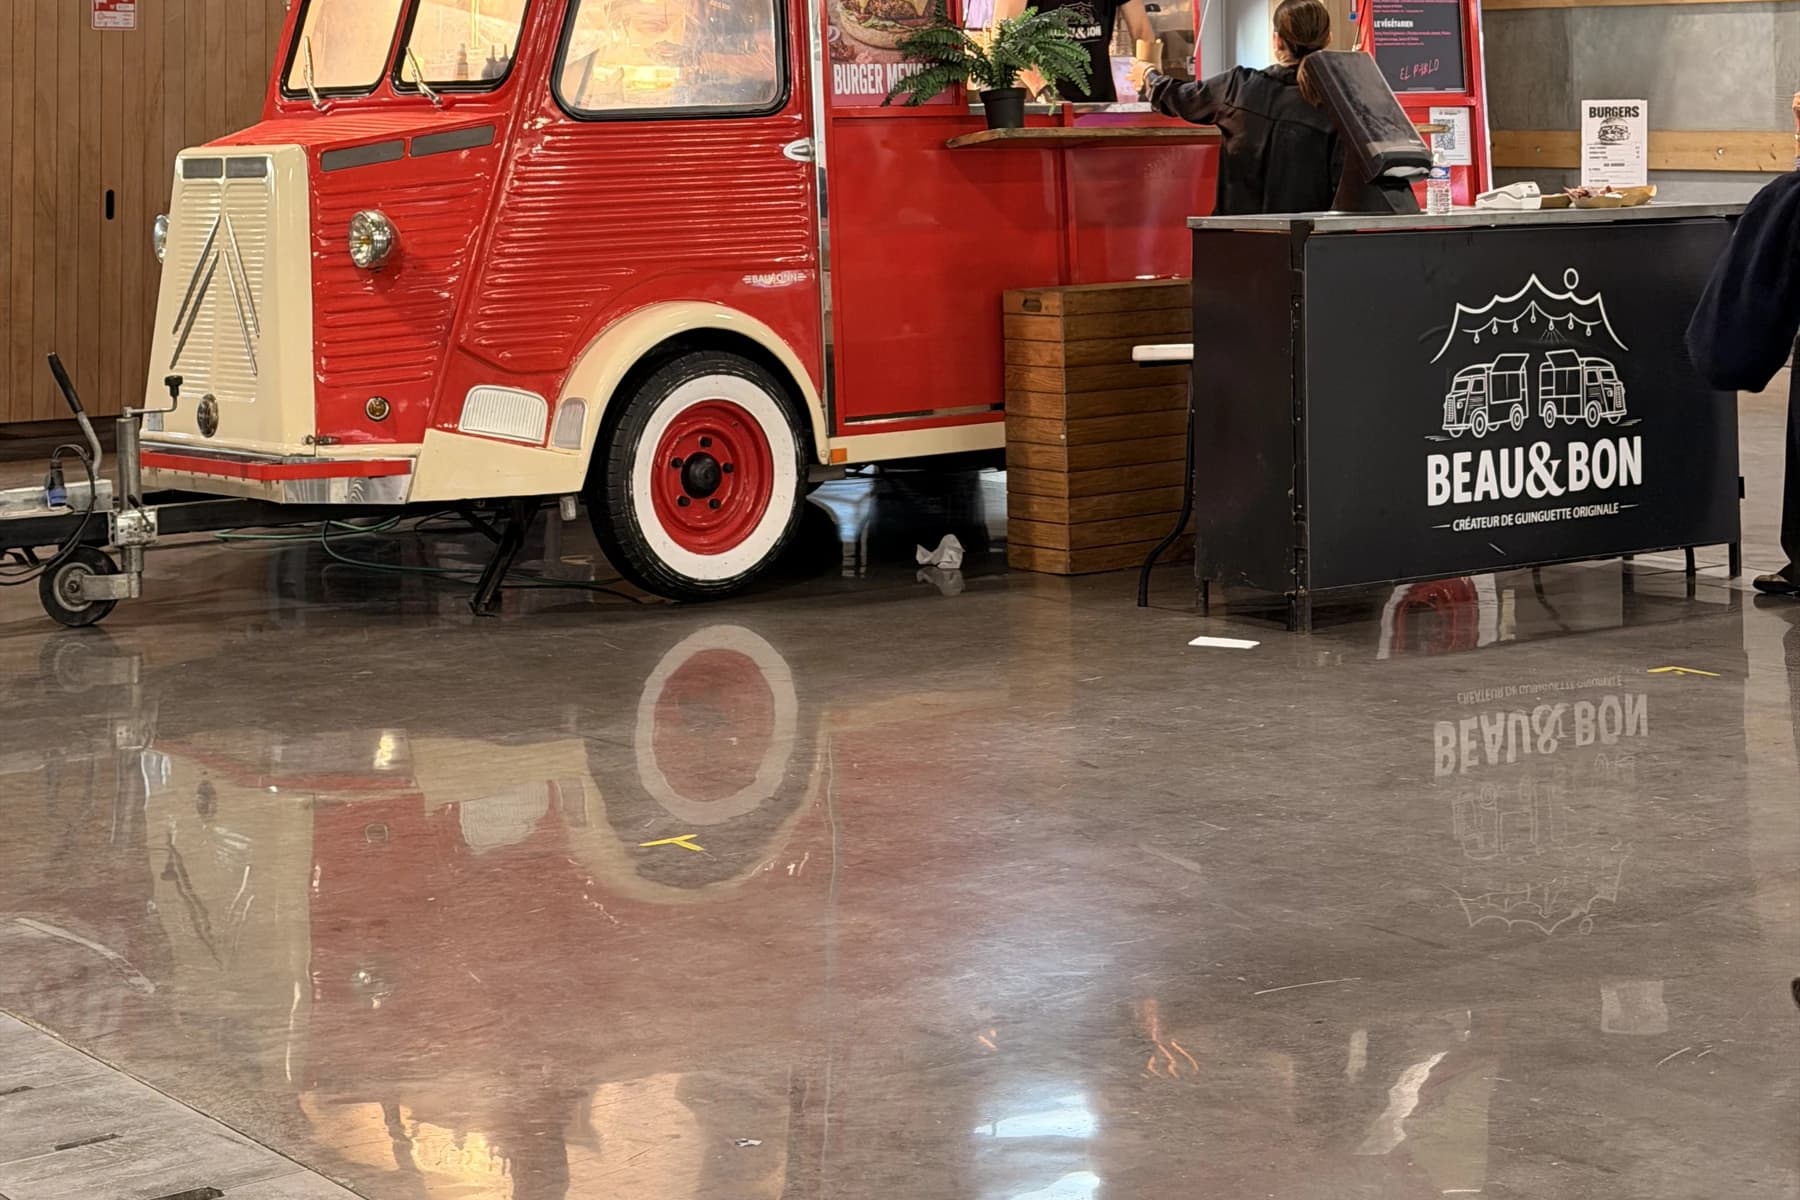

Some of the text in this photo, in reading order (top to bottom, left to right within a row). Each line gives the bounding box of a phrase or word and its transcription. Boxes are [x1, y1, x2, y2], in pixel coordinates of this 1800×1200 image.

[833, 63, 884, 95] BURGER
[1400, 65, 1411, 80] EL
[1588, 105, 1640, 118] BURGERS
[1568, 436, 1642, 492] BON
[1452, 502, 1619, 531] CRÉATEUR DE GUINGUETTE ORIGINALE
